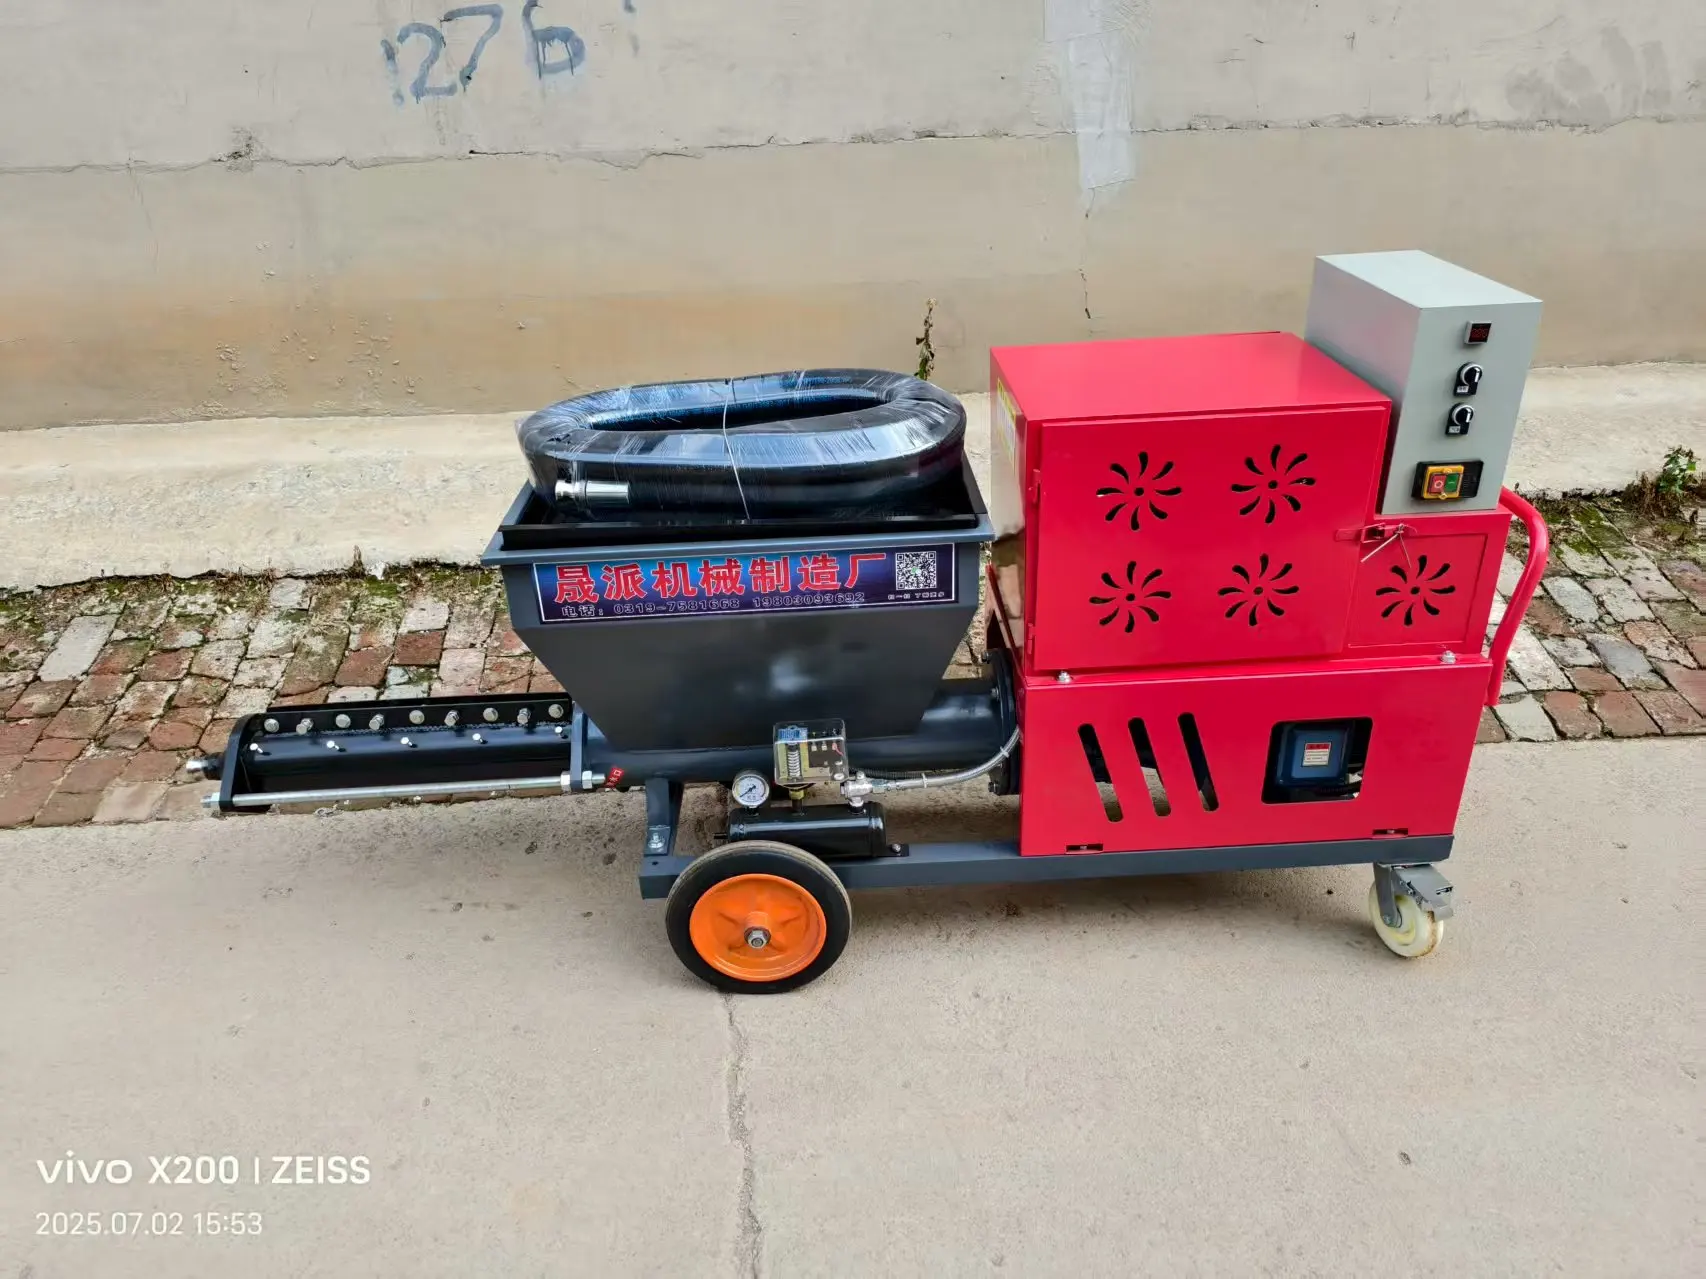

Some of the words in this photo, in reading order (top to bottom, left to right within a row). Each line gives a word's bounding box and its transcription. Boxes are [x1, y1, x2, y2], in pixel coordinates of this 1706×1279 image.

[554, 552, 887, 604] 晟派机械制造厂
[613, 597, 741, 615] 0319-7581668
[753, 591, 866, 608] 19803093692
